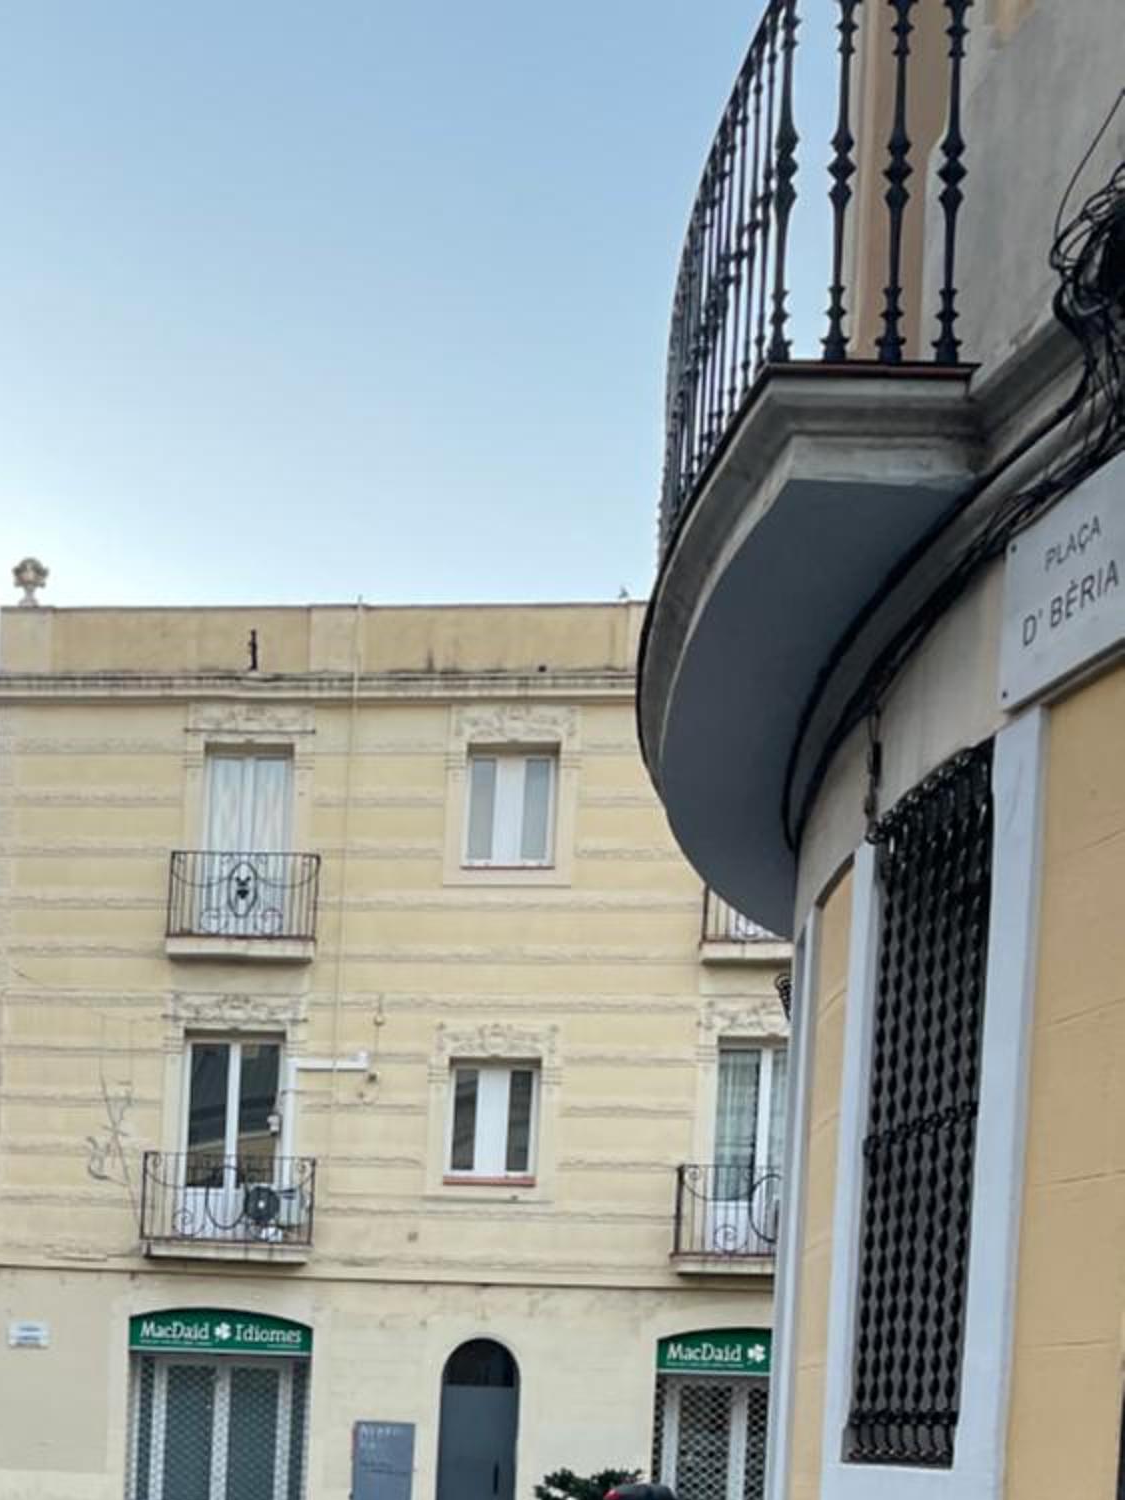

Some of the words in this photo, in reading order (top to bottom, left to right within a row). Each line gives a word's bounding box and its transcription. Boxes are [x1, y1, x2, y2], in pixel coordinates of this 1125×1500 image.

[1044, 514, 1102, 572] PLAÇA
[140, 1320, 210, 1340] MacDaid
[235, 1324, 302, 1343] Idiomes
[667, 1342, 742, 1362] MacDaid
